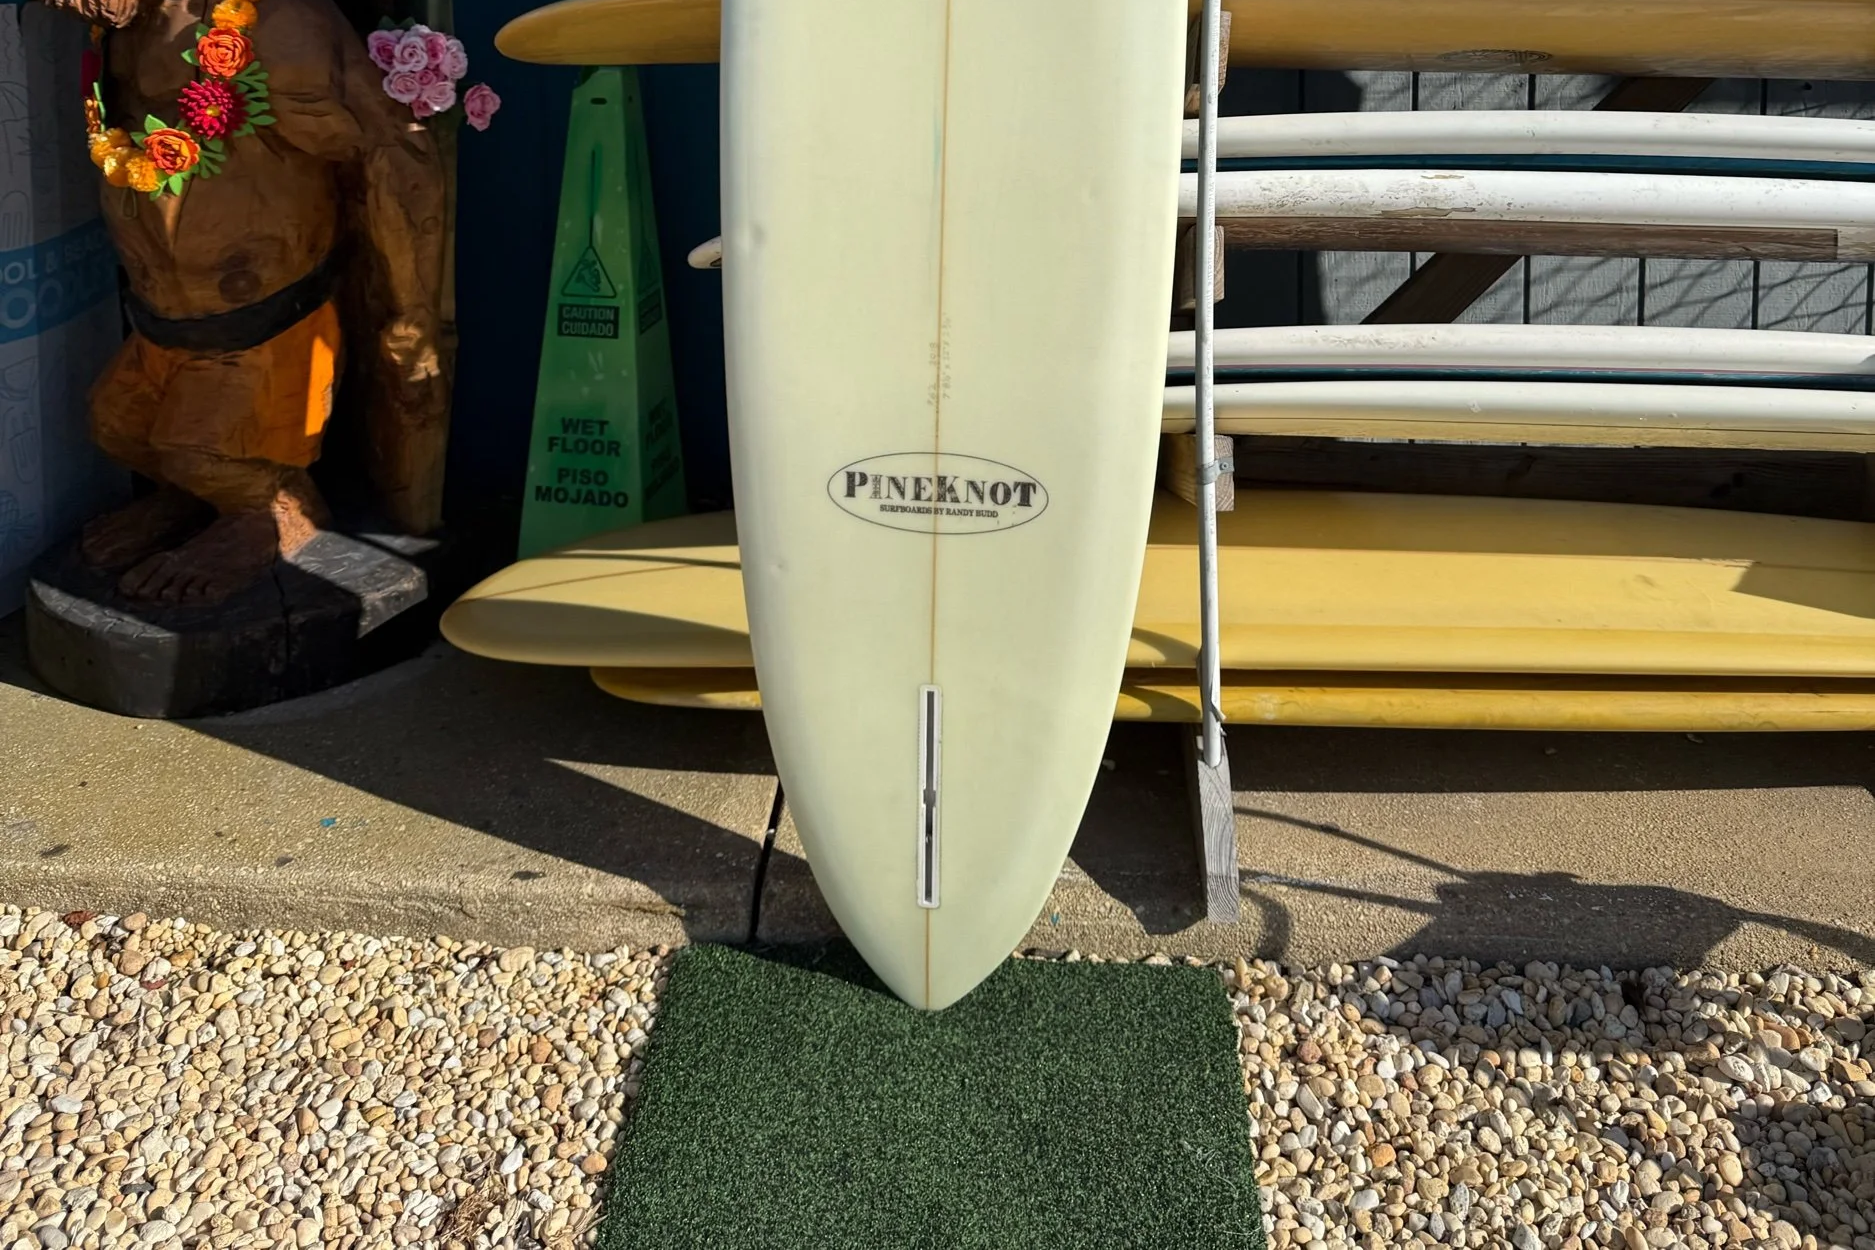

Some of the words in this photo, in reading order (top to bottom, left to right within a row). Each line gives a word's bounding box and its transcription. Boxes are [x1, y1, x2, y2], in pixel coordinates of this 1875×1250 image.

[562, 306, 615, 321] CAUTION
[561, 321, 615, 337] CUIDADO
[560, 417, 610, 437] WET
[547, 436, 621, 458] FLOOR
[557, 467, 609, 487] PISO
[534, 485, 629, 509] MOJADO
[843, 470, 1037, 508] PINEKNOT
[879, 504, 933, 515] SURFBOARDS
[933, 507, 944, 515] BY
[945, 508, 975, 517] RANDY
[975, 510, 999, 518] BUDD
